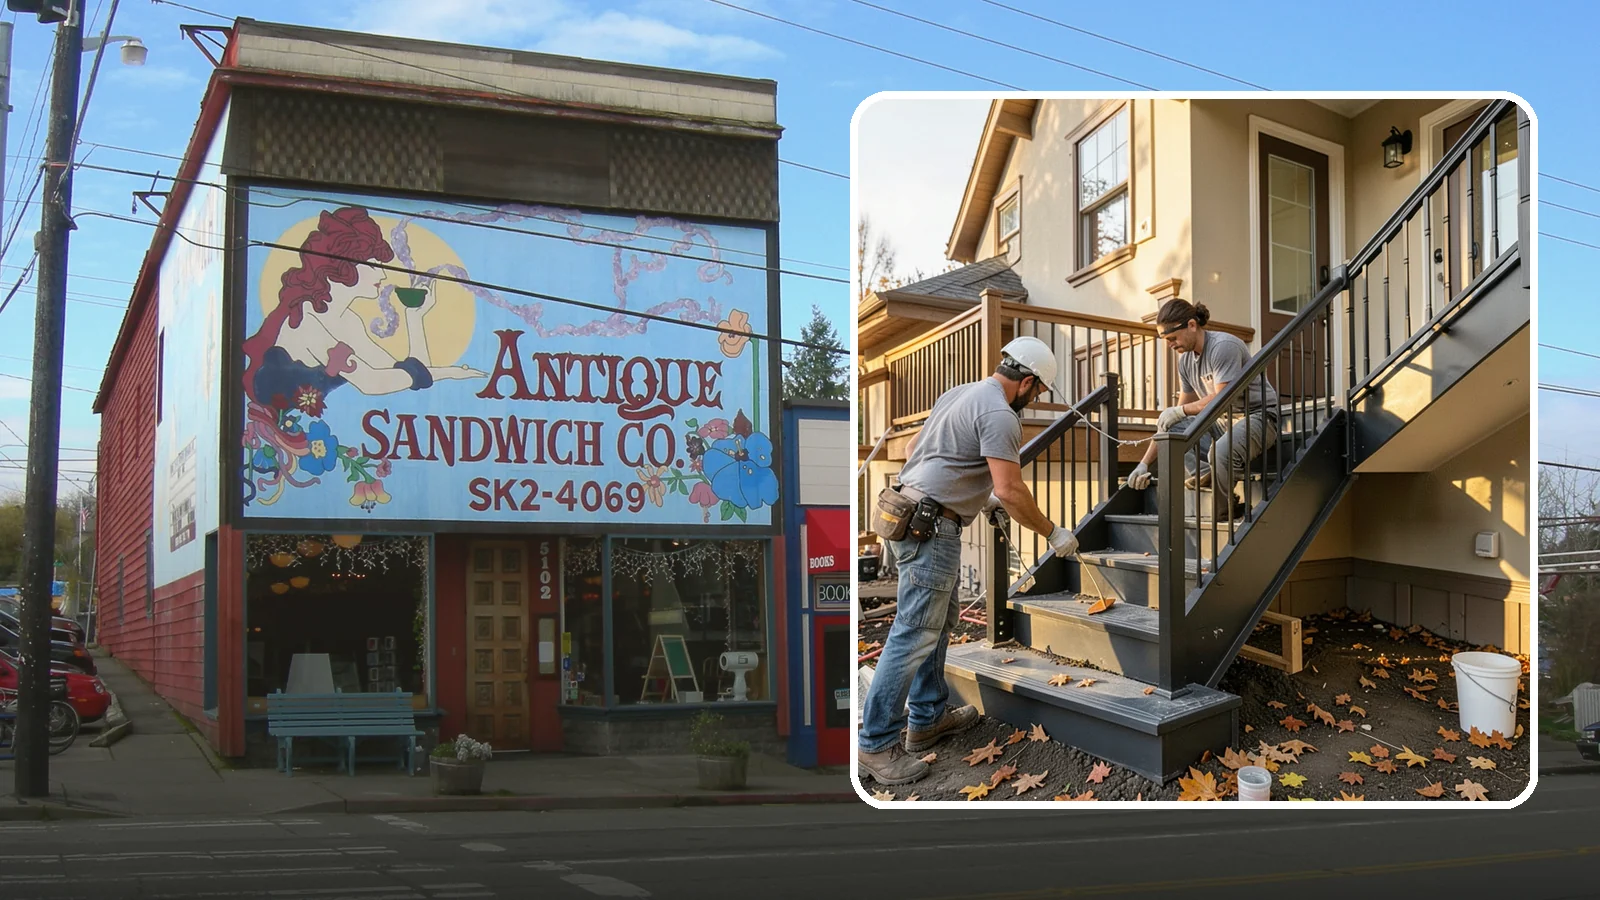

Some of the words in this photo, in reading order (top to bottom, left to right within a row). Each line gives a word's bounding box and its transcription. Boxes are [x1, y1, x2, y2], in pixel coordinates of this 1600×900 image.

[476, 329, 723, 421] ANTIQUE
[361, 409, 604, 467] SANDWICH
[617, 422, 685, 468] CO.
[469, 477, 645, 513] SK2-4069
[540, 542, 551, 600] 5102
[810, 555, 835, 569] BOOKS
